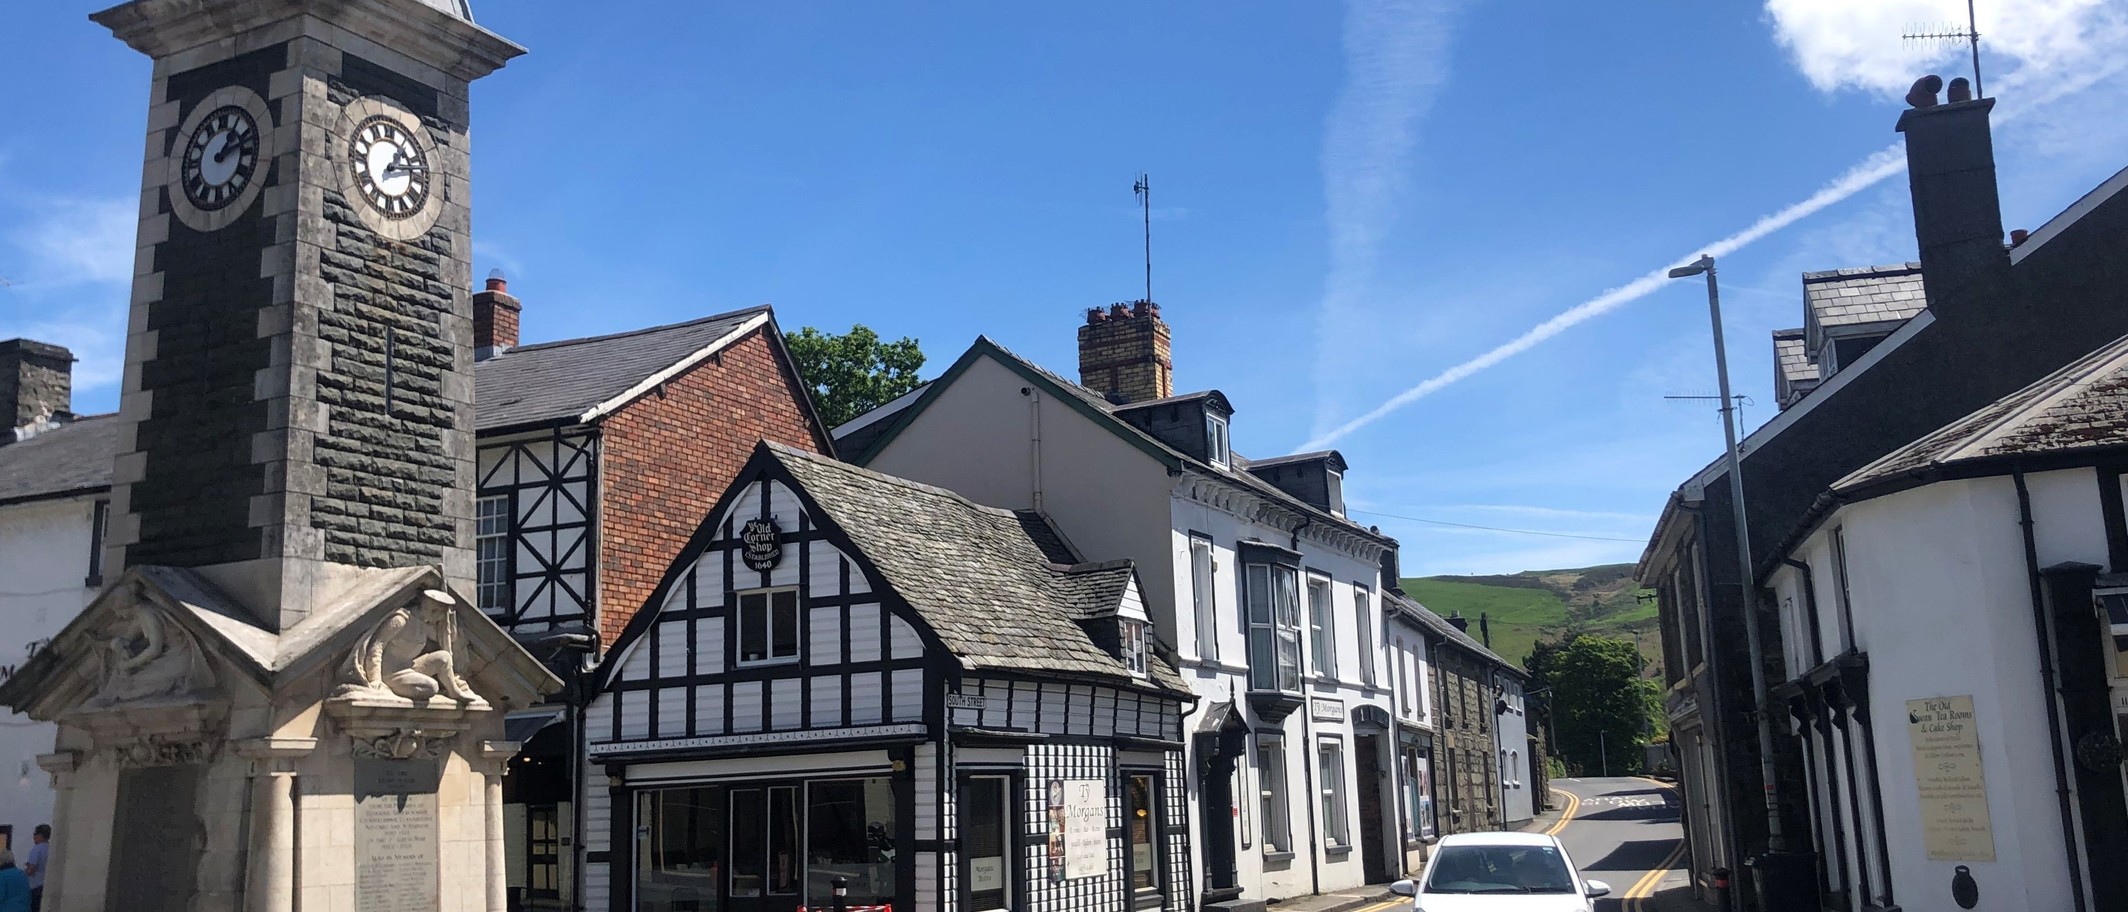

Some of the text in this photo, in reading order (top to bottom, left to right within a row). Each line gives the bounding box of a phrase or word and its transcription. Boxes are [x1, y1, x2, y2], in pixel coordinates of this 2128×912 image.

[757, 522, 771, 533] Old
[744, 532, 775, 543] Corner
[749, 543, 773, 553] Shop
[745, 549, 779, 560] ESTABLISHED
[755, 560, 772, 569] 1640
[948, 695, 986, 708] SOUTH STREET
[1924, 701, 1951, 711] The Old
[1910, 710, 1972, 724] Swan Tea Rooms
[1921, 721, 1963, 734] & Cake Shop
[1066, 804, 1104, 822] Morgans
